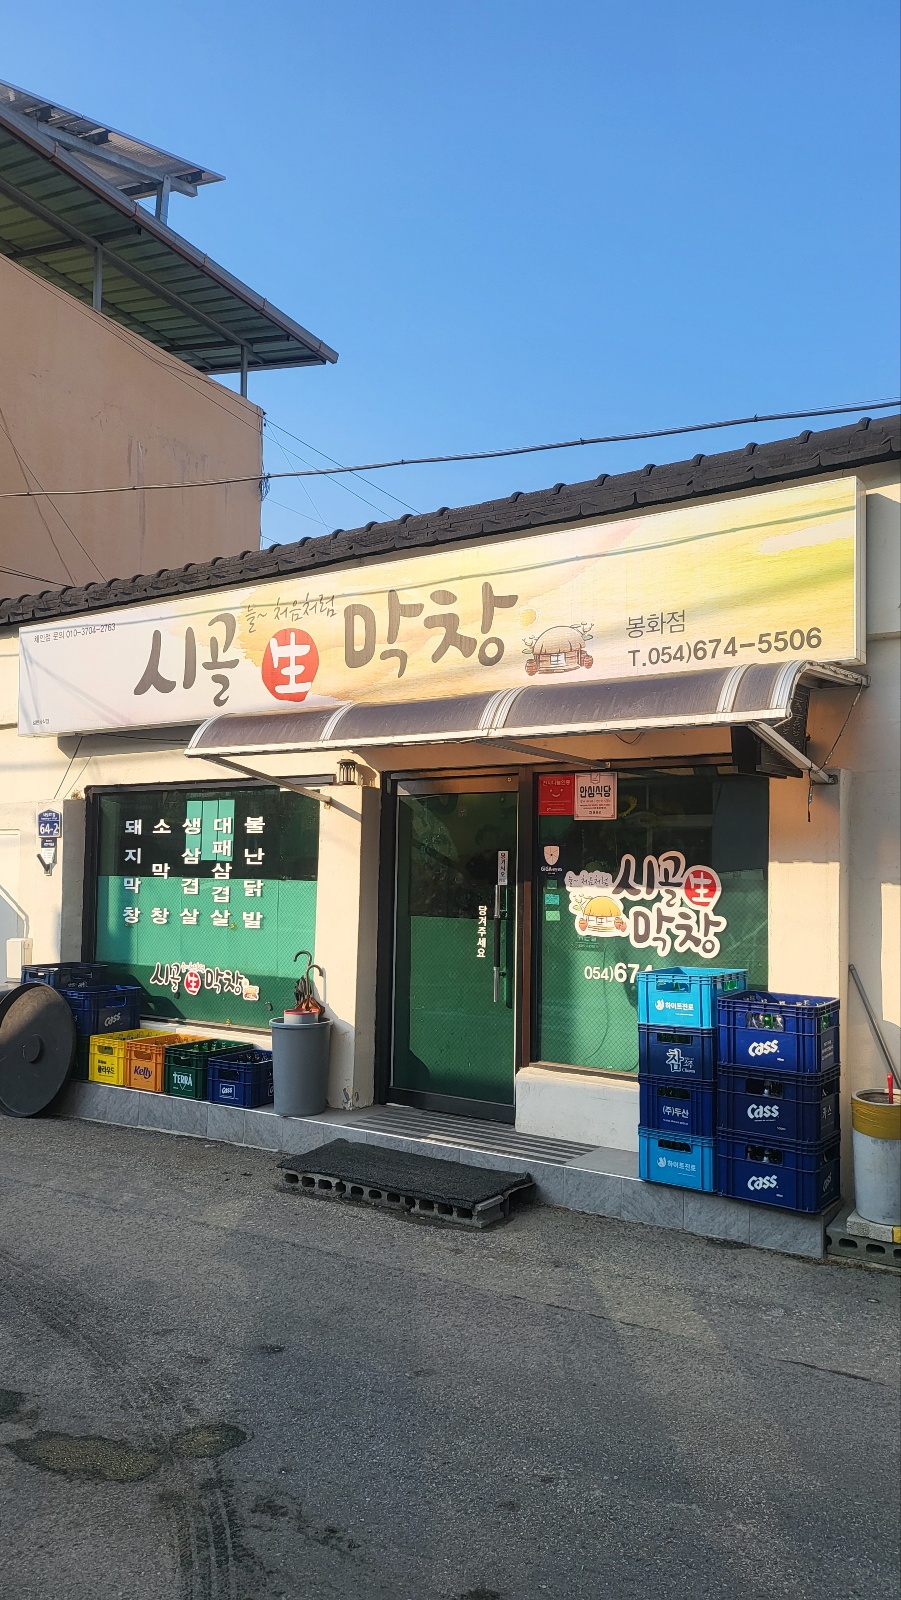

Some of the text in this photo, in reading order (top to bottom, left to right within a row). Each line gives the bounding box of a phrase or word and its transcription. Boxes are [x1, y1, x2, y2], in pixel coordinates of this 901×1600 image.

[274, 592, 338, 622] 처음처럼
[625, 609, 686, 639] 봉화점
[33, 633, 51, 644] 체인점
[53, 630, 65, 641] 문의
[133, 581, 519, 707] 시골 生 막창
[627, 626, 823, 667] T.054)674-5506
[580, 784, 612, 799] 안심식당
[39, 823, 59, 835] 64-2
[122, 818, 142, 924] 돼지막창
[180, 817, 202, 925] 생삼겹살
[210, 816, 233, 927] 대패삼겹살
[243, 815, 266, 929] 불난닭발
[612, 855, 683, 908] 시골
[476, 905, 487, 958] 당겨주세요
[633, 907, 722, 954] 막창
[150, 963, 181, 992] 시골
[205, 967, 243, 994] 막창
[665, 1001, 695, 1011] 하이트진로
[104, 1012, 121, 1027] Cass
[666, 1048, 684, 1073] 참
[748, 1039, 779, 1057] Cass
[133, 1065, 153, 1079] Kelly
[172, 1071, 193, 1087] TERRA
[662, 1105, 690, 1119] (주)두산
[747, 1103, 780, 1119] Cass
[667, 1159, 697, 1172] 하이트진로
[747, 1174, 778, 1191] Cass
